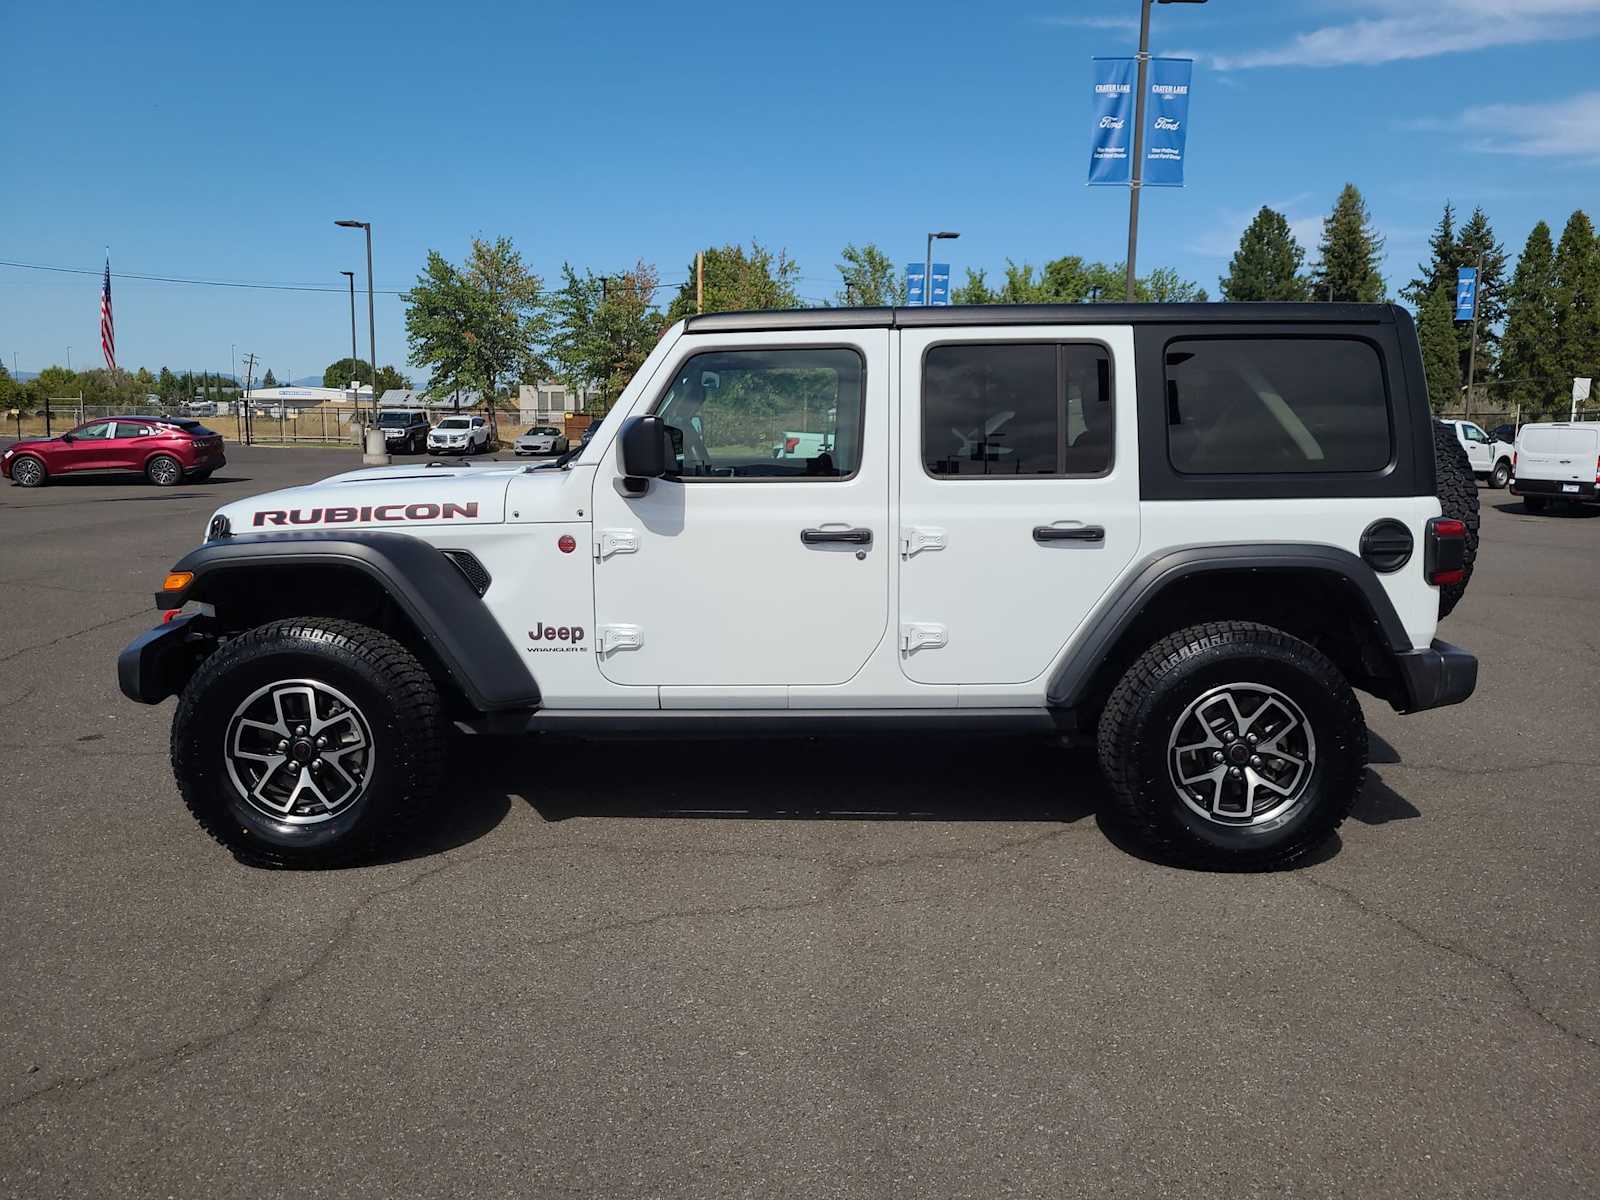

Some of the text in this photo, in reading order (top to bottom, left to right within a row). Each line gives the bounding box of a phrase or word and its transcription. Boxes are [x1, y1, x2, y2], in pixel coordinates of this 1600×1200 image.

[1174, 85, 1188, 95] LAKE
[1099, 115, 1125, 129] Ford
[1154, 116, 1180, 130] Ford
[253, 502, 479, 526] RUBICON
[528, 622, 585, 644] Jeep
